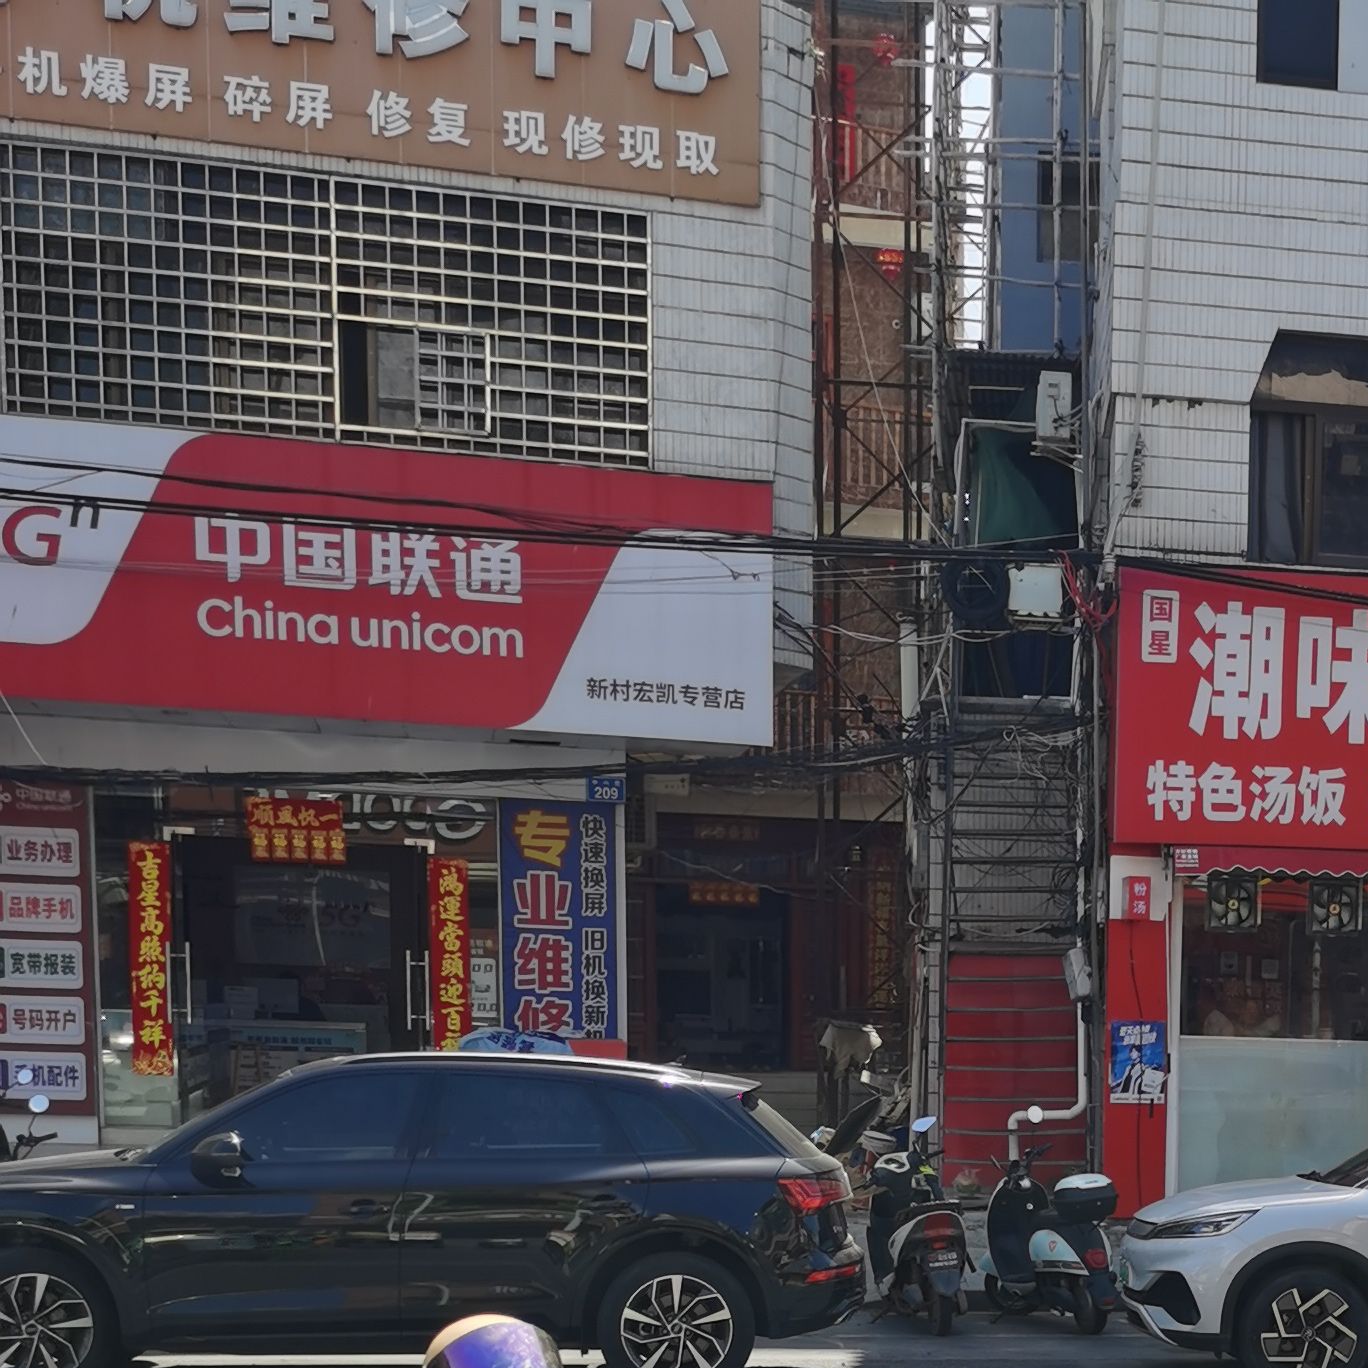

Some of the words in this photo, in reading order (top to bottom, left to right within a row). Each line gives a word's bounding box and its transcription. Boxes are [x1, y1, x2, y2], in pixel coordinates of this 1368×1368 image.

[18, 47, 194, 113] 机爆屏
[224, 75, 333, 130] 碎屏
[367, 89, 470, 147] 修复
[503, 109, 720, 176] 现修现取
[193, 512, 523, 604] 中国联通
[196, 595, 340, 646] China
[351, 609, 524, 659] unicom
[1147, 594, 1175, 656] 国星
[585, 677, 746, 712] 新村宏凯专营店
[594, 786, 619, 799] 209
[1146, 759, 1347, 826] 特色汤饭
[7, 839, 73, 864] 业务办理
[580, 814, 608, 917] 快速换屏
[8, 896, 75, 920] 品牌手机
[10, 951, 77, 977] 宽带报装
[12, 1009, 77, 1032] 号码开户
